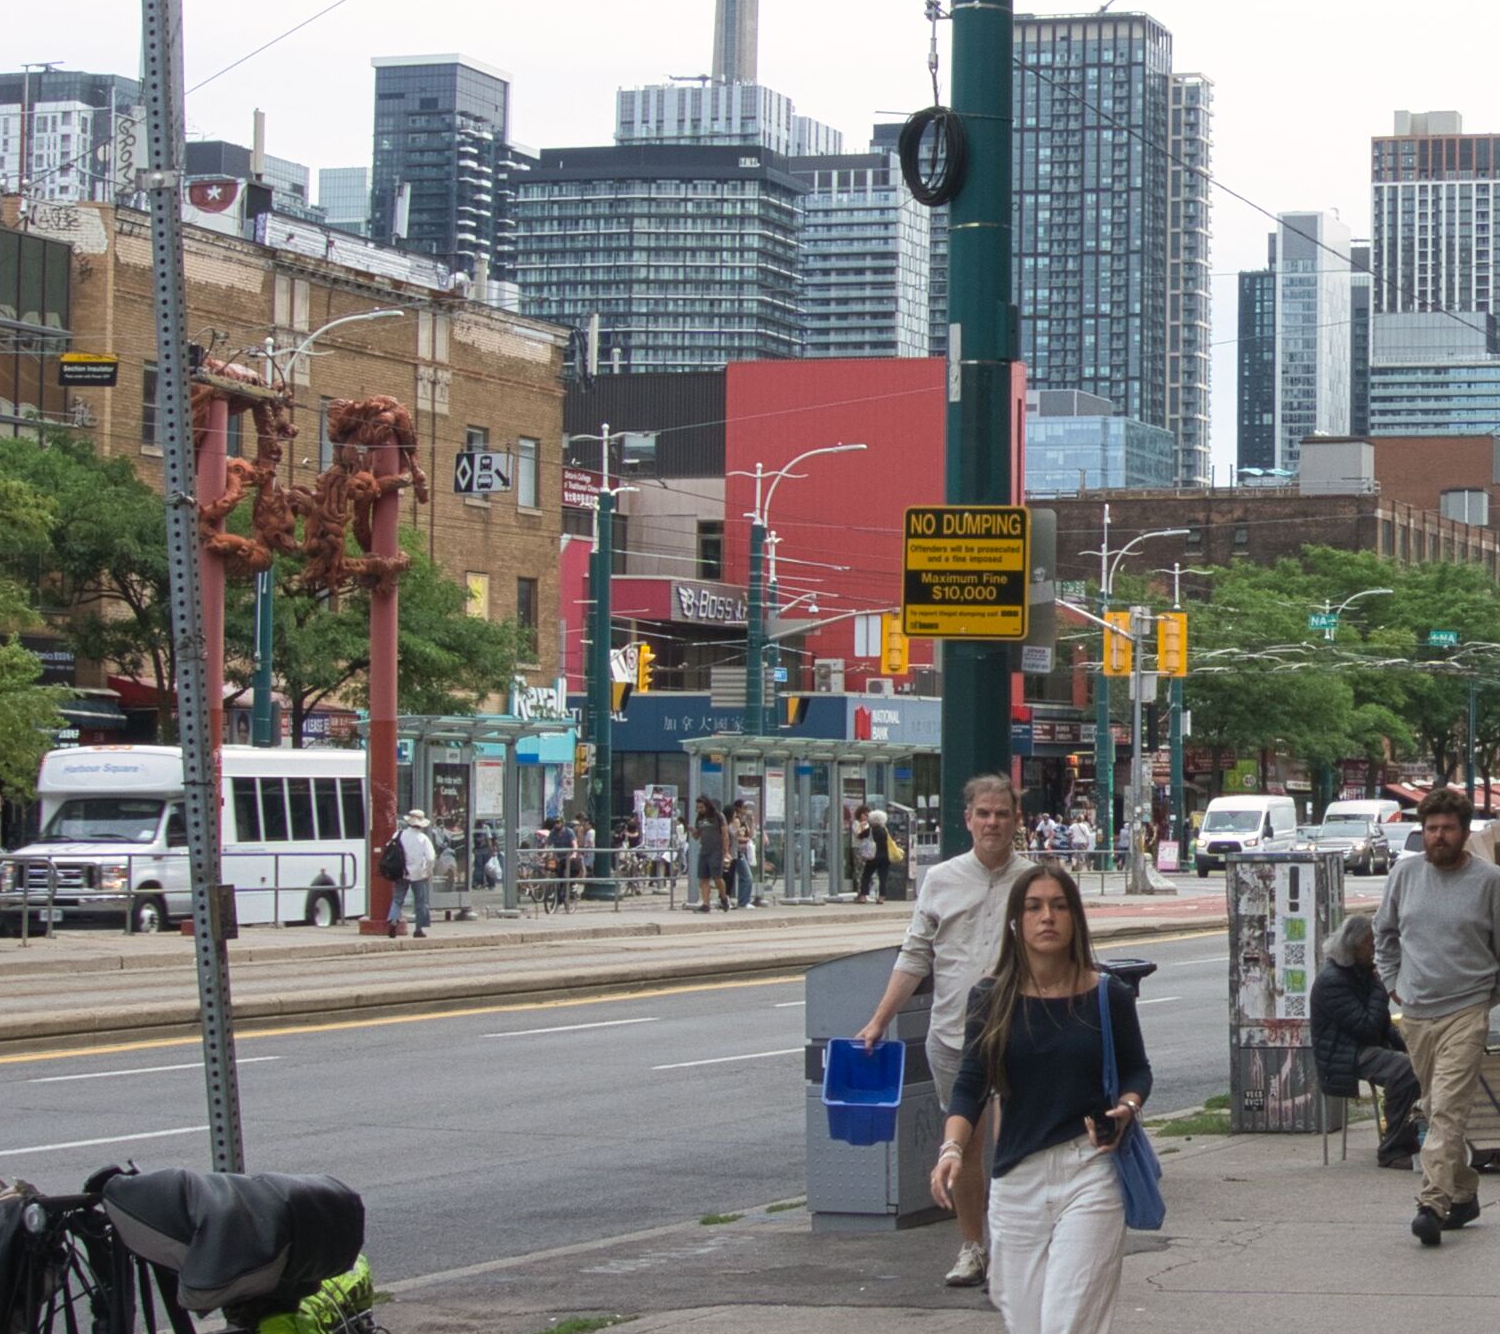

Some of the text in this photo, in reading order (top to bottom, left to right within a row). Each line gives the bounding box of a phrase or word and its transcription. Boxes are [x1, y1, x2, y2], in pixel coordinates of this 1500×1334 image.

[911, 513, 1021, 535] NO DUMPING
[911, 544, 1020, 556] Offenders will be prosecuted
[928, 554, 942, 564] and
[952, 554, 967, 564] fine
[970, 554, 1003, 565] imposed
[921, 572, 1008, 584] Maximum Fine
[931, 585, 997, 602] $10,000
[871, 710, 899, 725] NATIONAL
[871, 725, 889, 741] BANK
